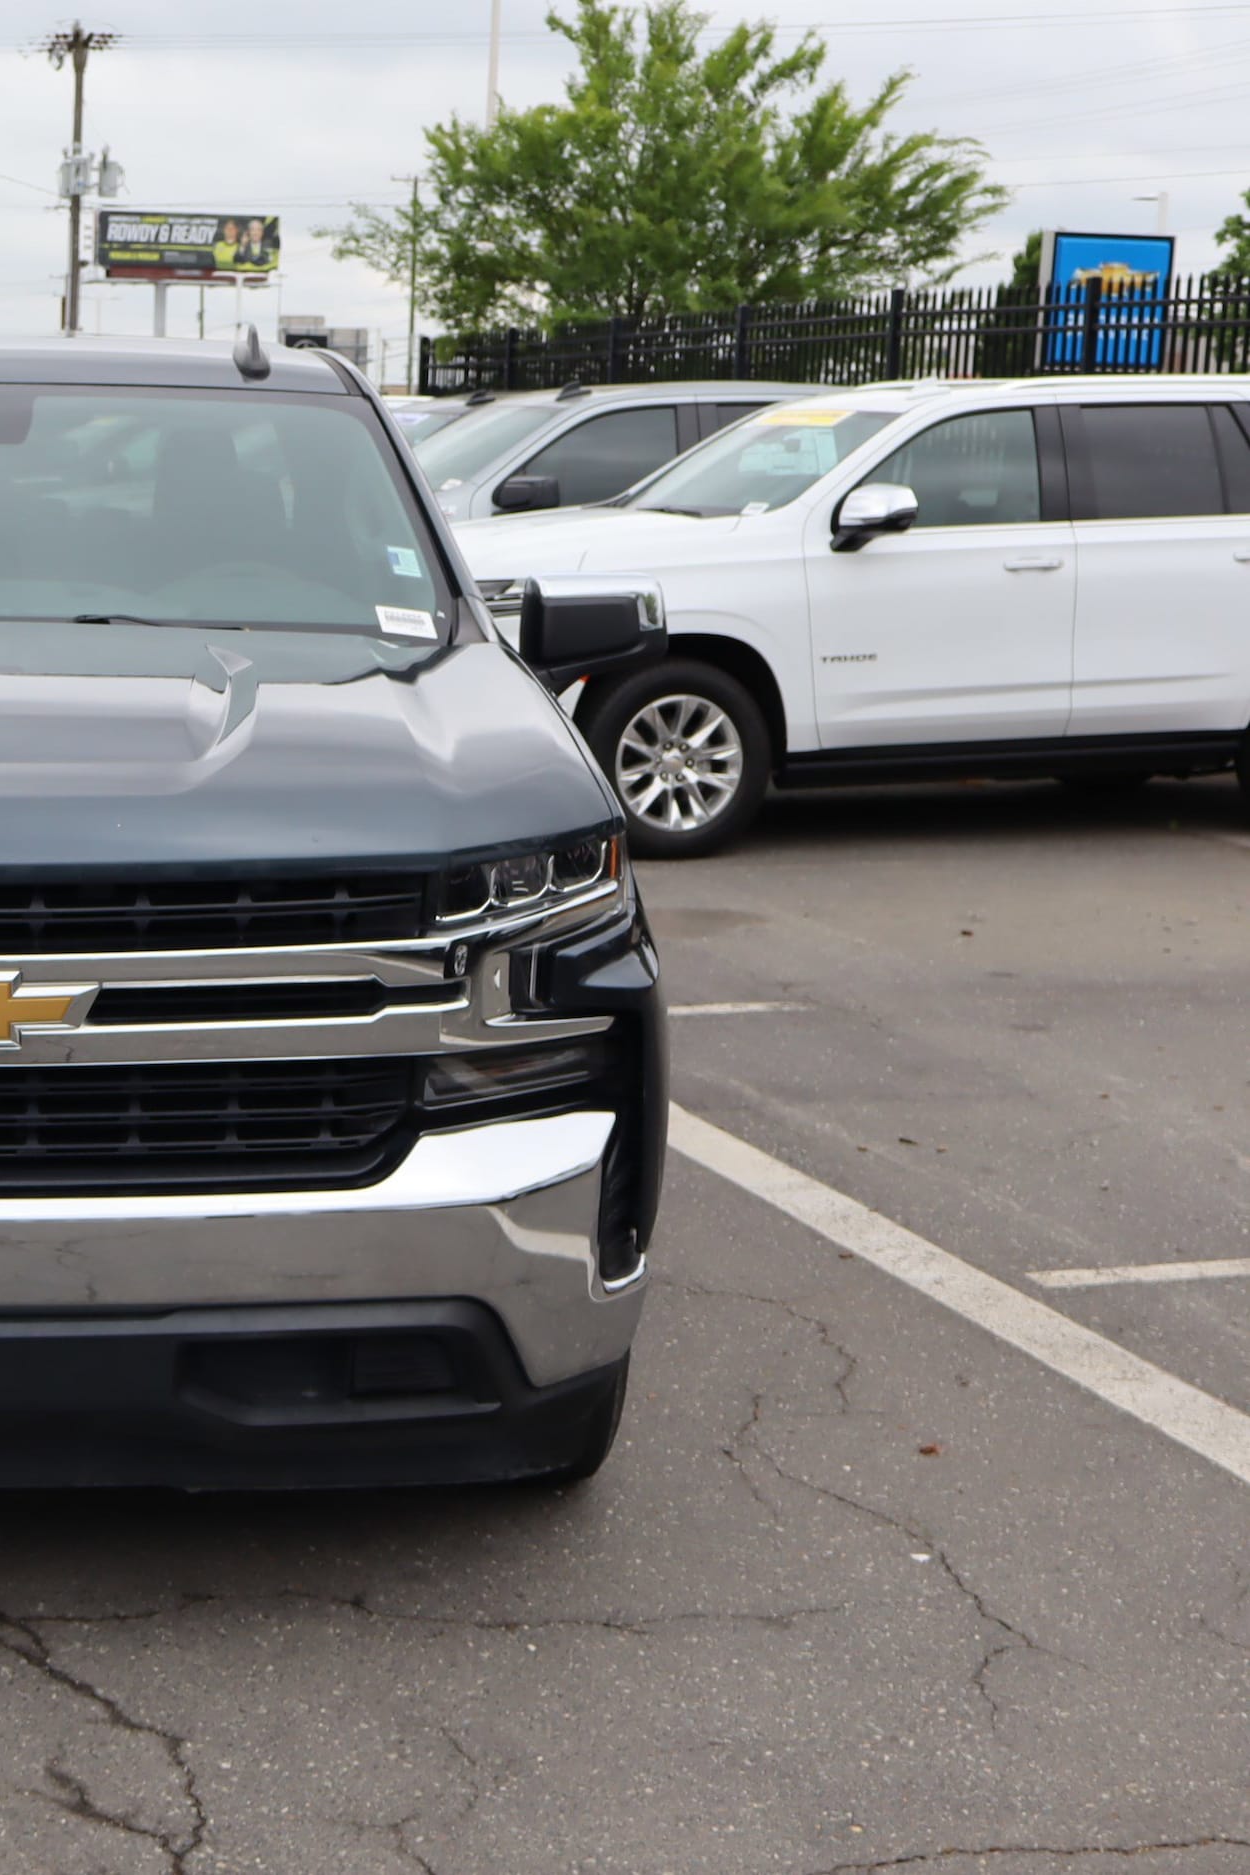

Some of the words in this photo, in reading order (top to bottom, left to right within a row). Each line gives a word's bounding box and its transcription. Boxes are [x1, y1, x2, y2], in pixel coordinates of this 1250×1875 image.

[106, 223, 159, 242] ROWDY
[170, 224, 218, 244] READY
[821, 653, 878, 664] TAHOE
